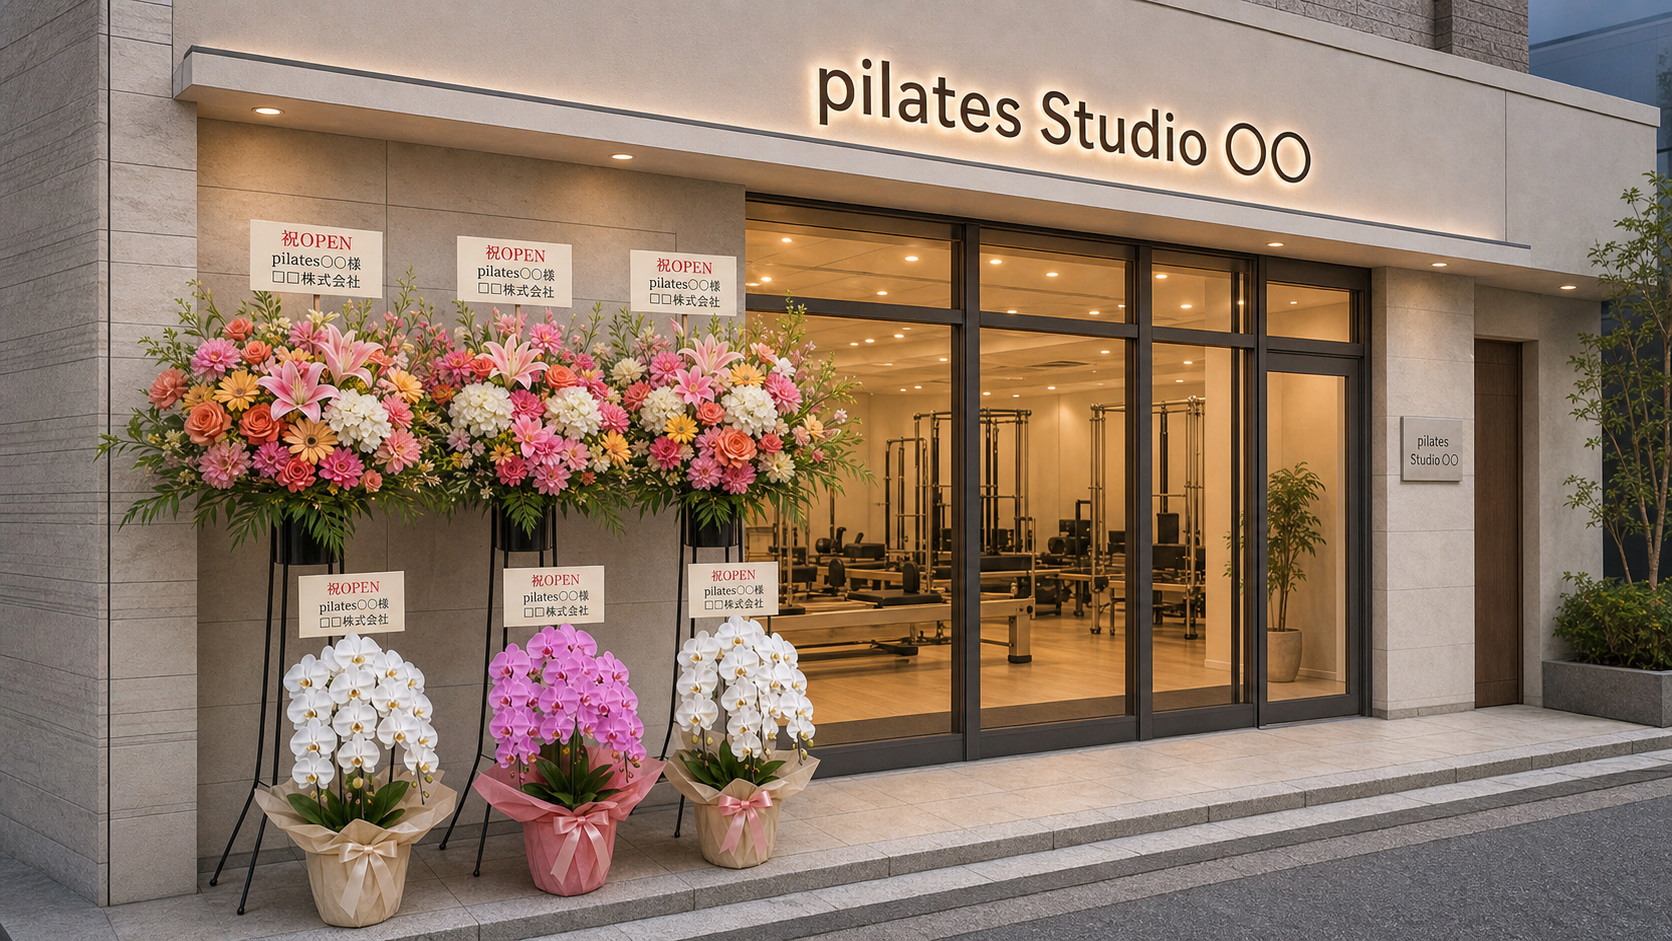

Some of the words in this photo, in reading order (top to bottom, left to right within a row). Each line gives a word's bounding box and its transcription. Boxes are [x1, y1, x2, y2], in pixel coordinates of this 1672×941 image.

[818, 58, 1022, 138] pilates
[1040, 90, 1208, 166] Studio
[281, 229, 353, 251] 祝OPEN
[486, 245, 546, 263] 祝OPEN
[657, 258, 713, 275] 祝OPEN
[1417, 434, 1449, 450] pilates
[1410, 453, 1441, 466] Studio
[531, 574, 580, 588] 祝OPEN
[711, 570, 756, 582] 祝OPEN
[327, 581, 380, 596] 祝OPEN
